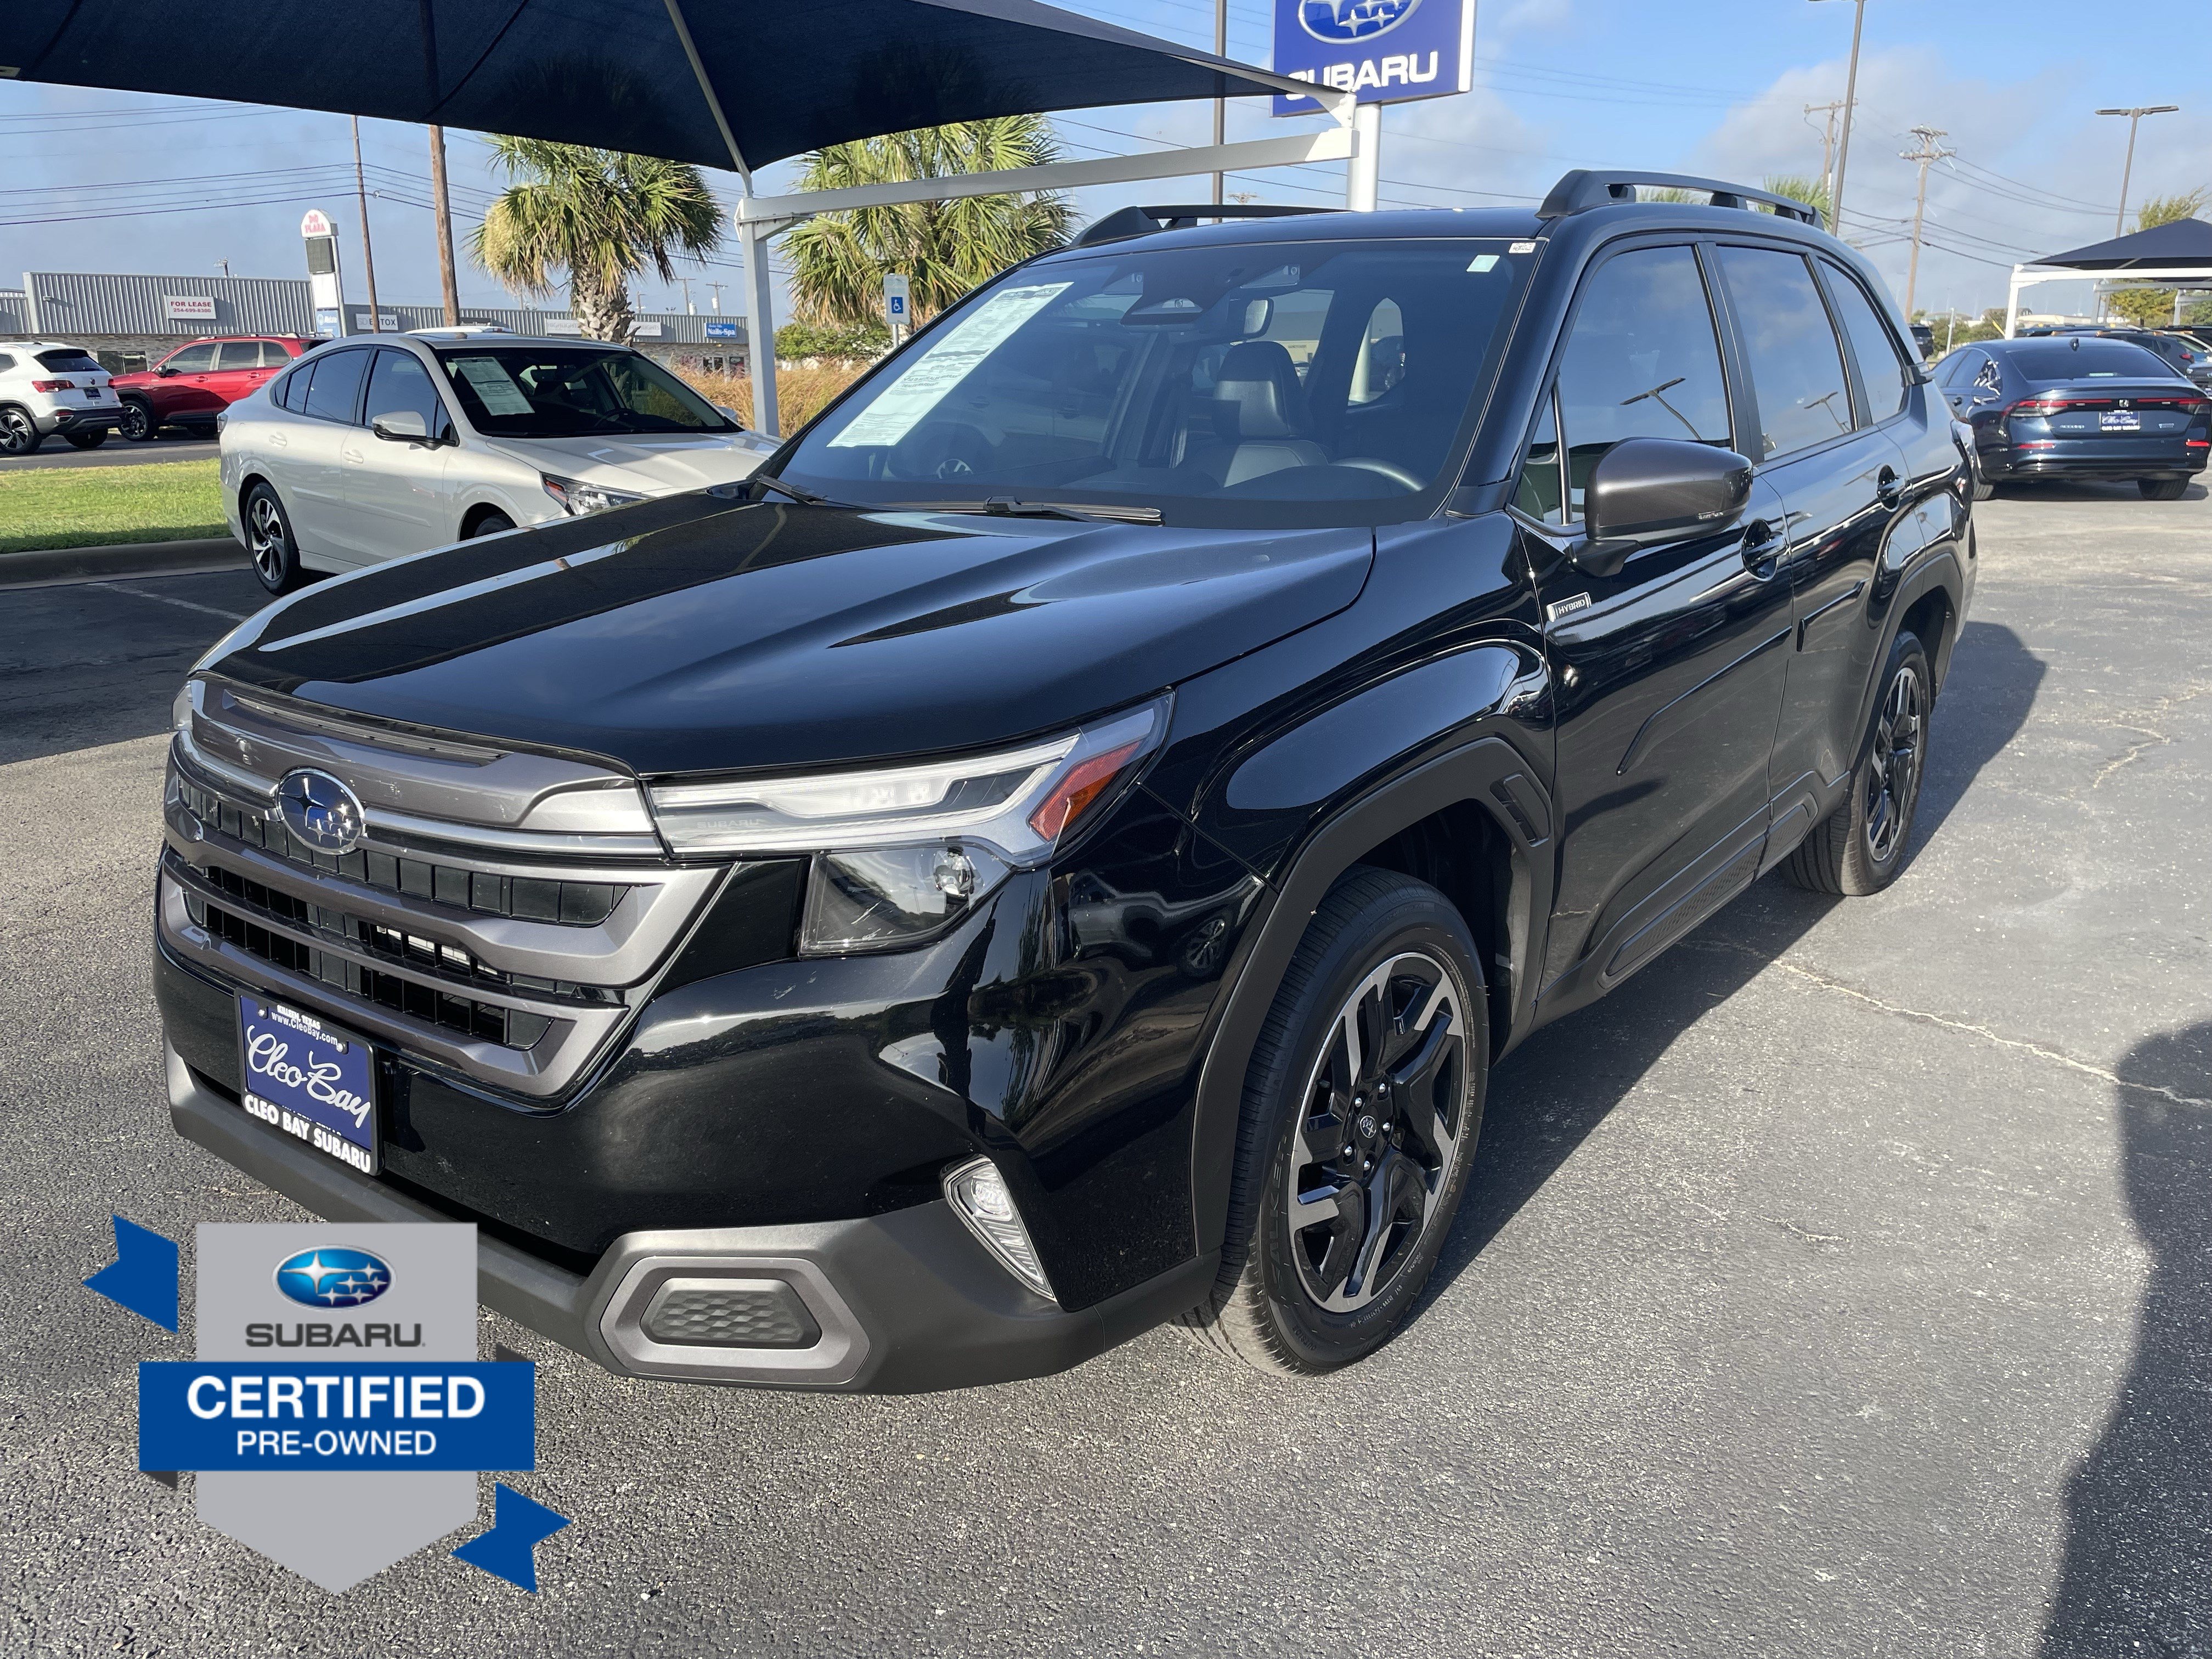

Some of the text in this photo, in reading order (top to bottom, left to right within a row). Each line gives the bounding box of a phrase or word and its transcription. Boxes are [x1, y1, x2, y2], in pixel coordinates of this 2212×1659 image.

[1558, 599, 1585, 614] HYBRID
[697, 819, 759, 828] SUBARU
[271, 1012, 338, 1046] www.CleoBay.com
[301, 1015, 321, 1030] TEXAS
[247, 1025, 307, 1088] Cleo
[306, 1051, 371, 1128] Bay
[245, 1095, 279, 1125] CLEO
[283, 1111, 310, 1141] BAY
[314, 1127, 371, 1173] SUBARU
